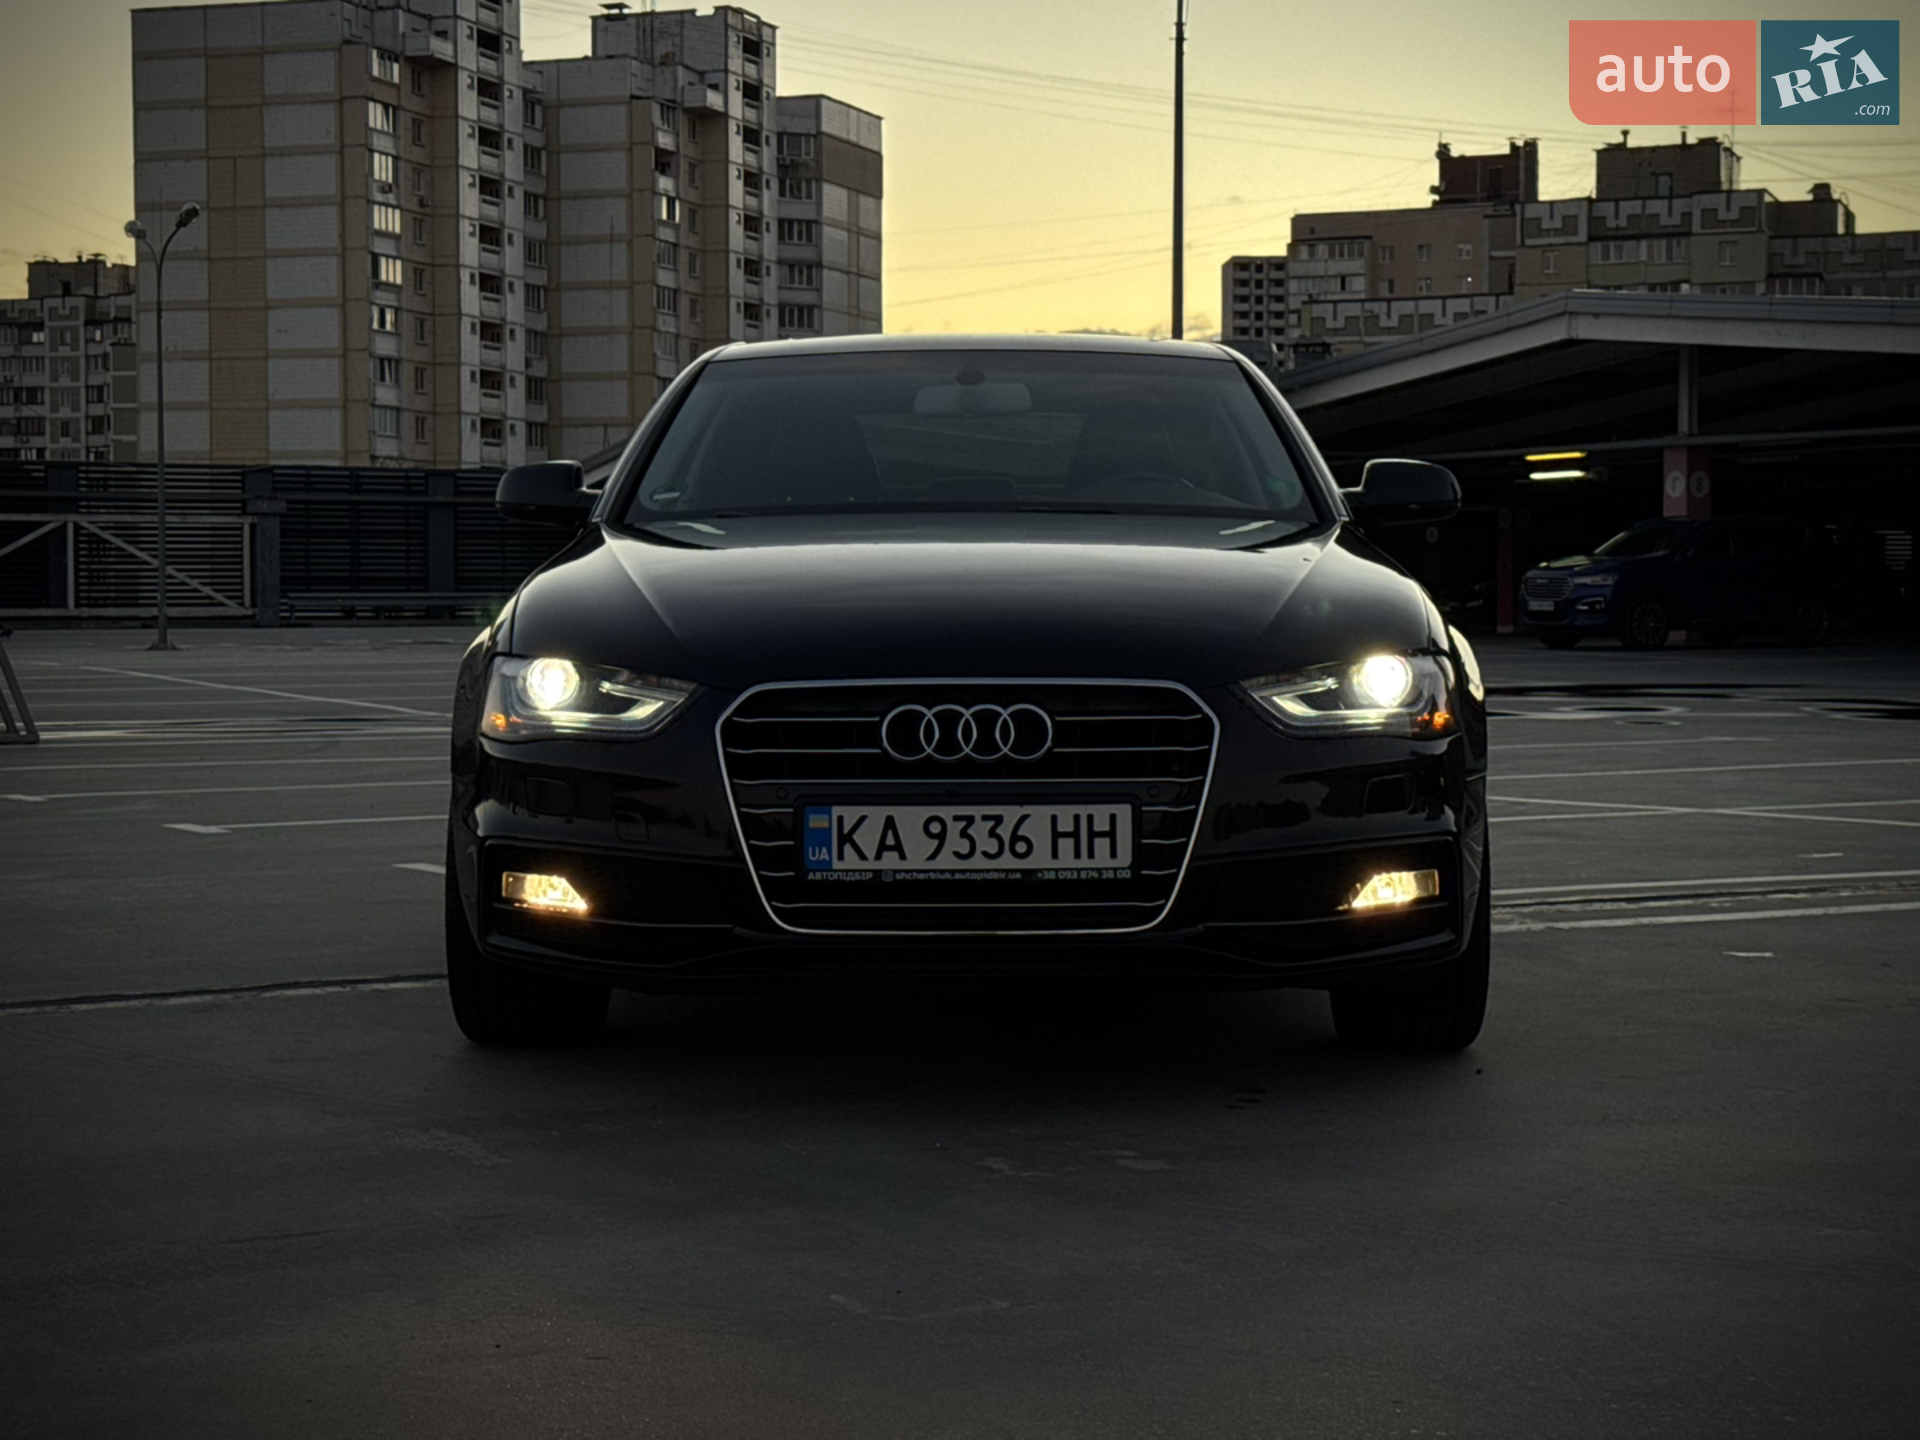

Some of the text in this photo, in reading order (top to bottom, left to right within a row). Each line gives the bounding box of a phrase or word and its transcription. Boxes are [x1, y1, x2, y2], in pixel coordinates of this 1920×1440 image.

[836, 812, 1118, 861] KA 9336 HH
[808, 846, 830, 861] UA
[807, 871, 873, 881] АВТОПІДБІР
[1036, 869, 1131, 879] +38 093 874 38 00
